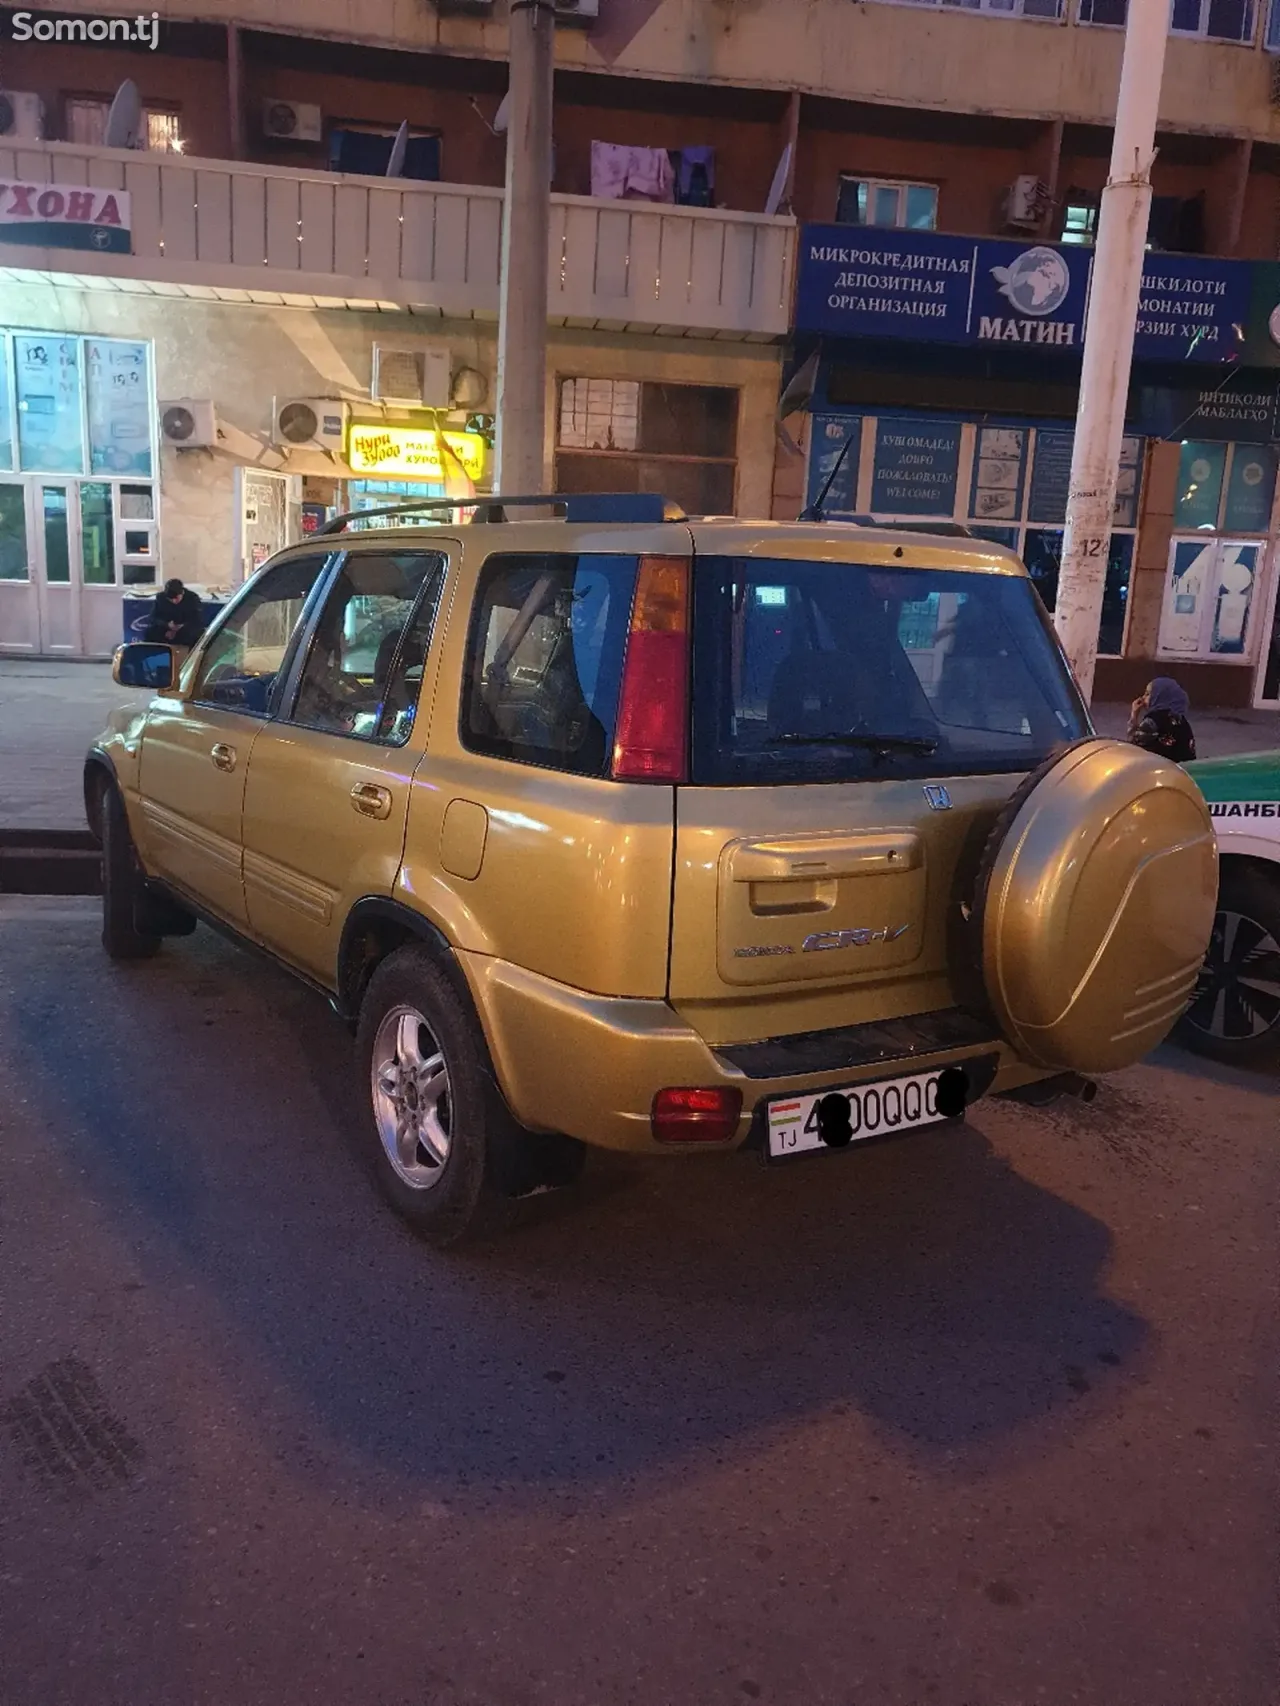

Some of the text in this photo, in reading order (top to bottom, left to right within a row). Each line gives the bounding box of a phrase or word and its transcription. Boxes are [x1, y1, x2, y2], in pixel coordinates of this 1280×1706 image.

[810, 246, 970, 273] МИКРОКРЕДИТНАЯ
[834, 272, 946, 295] ДЕПОЗИТНАЯ
[827, 295, 947, 317] ОРГАНИЗАЦИЯ
[977, 316, 1076, 345] МАТИН
[778, 1129, 797, 1149] TJ
